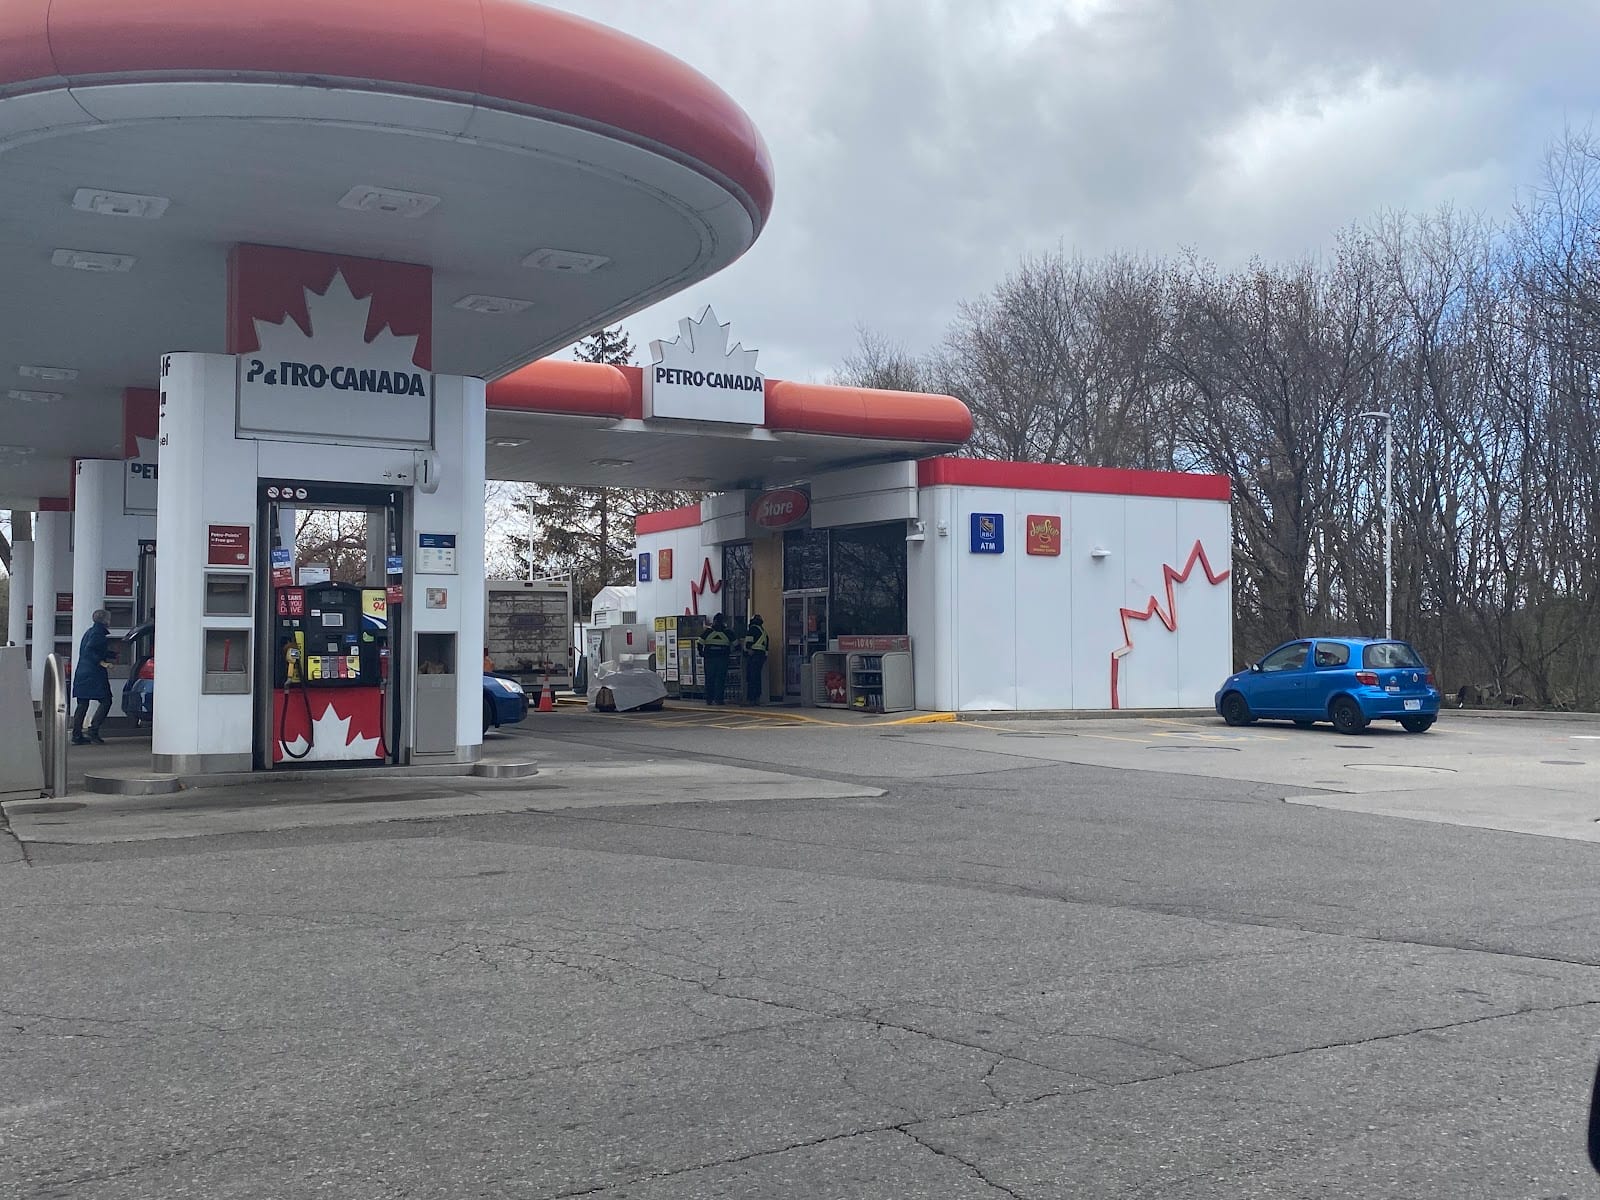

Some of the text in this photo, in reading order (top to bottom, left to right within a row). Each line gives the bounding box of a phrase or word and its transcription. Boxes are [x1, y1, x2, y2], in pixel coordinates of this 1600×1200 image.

[656, 367, 763, 392] PETRO-CANADA
[981, 542, 995, 550] ATM
[373, 602, 385, 612] 94
